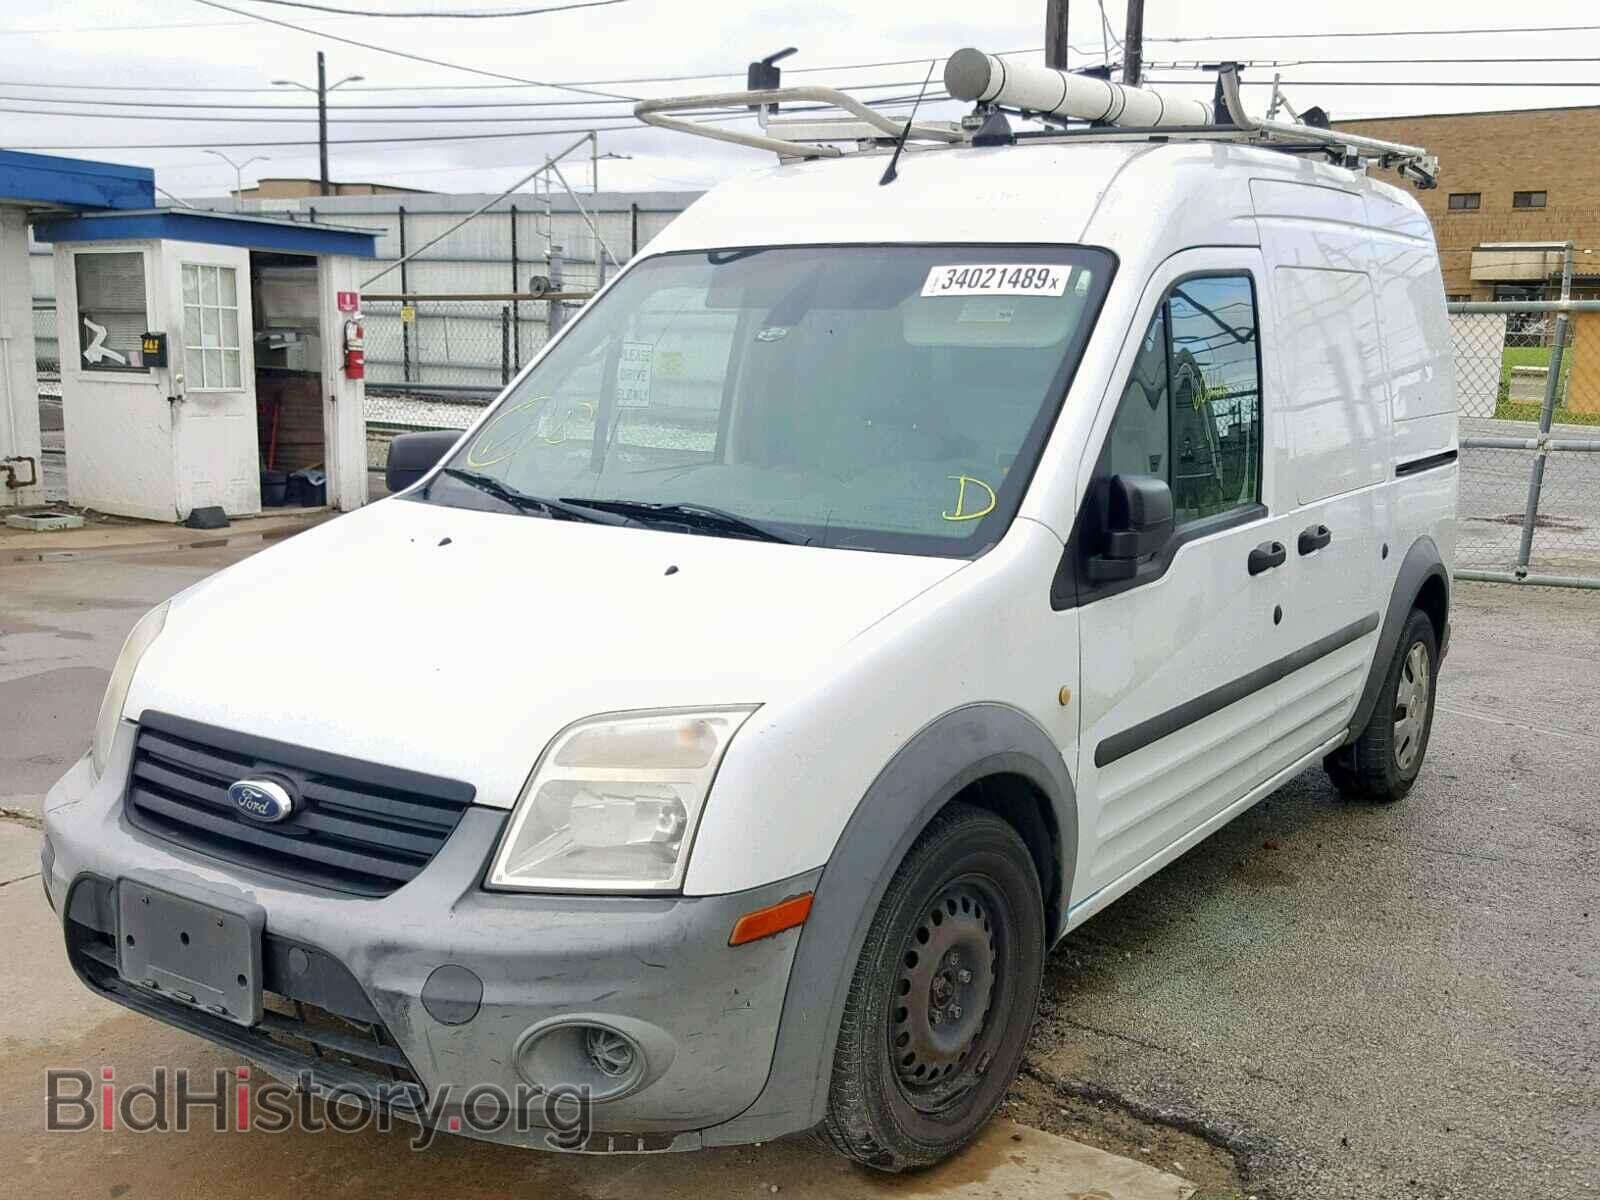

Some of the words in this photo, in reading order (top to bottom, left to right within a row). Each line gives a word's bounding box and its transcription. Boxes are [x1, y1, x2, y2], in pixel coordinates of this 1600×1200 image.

[617, 349, 651, 362] LEASE
[619, 368, 648, 383] DRIVE
[942, 474, 996, 521] D
[238, 788, 270, 815] Ford
